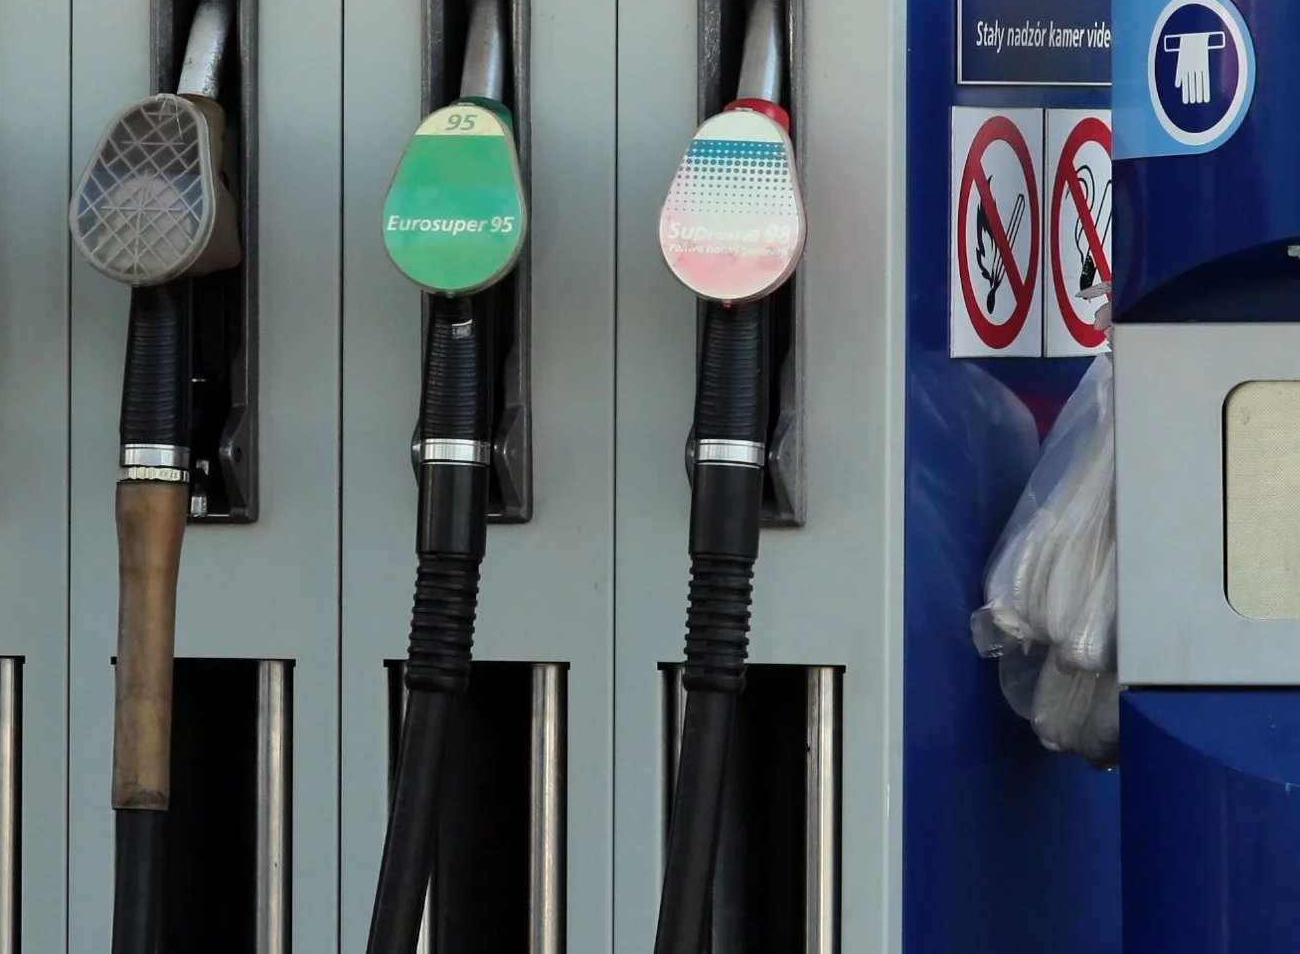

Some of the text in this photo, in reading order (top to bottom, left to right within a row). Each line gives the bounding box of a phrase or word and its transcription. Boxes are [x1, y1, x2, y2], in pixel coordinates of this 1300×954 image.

[976, 20, 1111, 53] Stały nadzór kamer vide
[445, 114, 478, 131] 95
[387, 215, 515, 236] Eurosuper 95
[765, 224, 792, 244] 98
